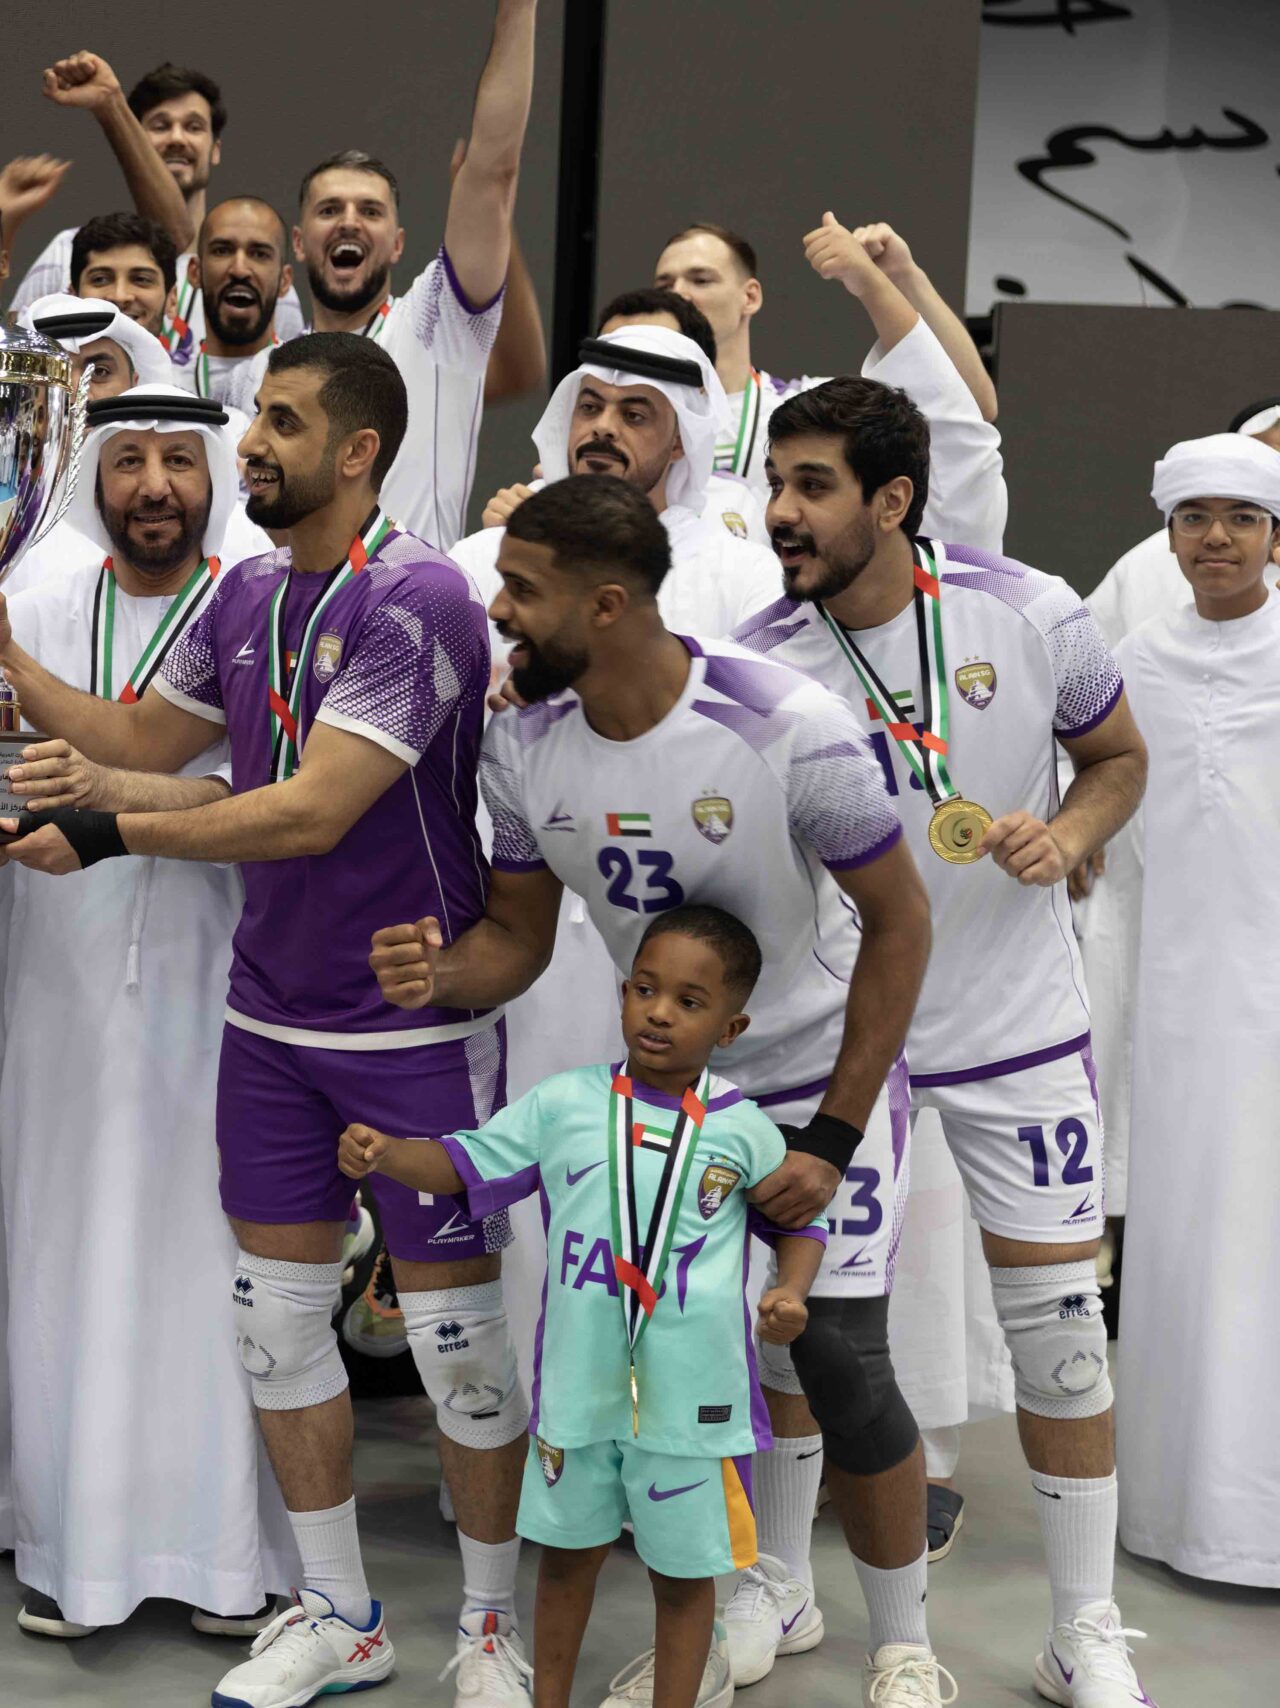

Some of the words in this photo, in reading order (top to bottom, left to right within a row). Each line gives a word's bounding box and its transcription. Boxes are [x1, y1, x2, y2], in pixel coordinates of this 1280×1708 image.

[597, 846, 685, 914] 23
[1016, 1117, 1094, 1187] 12
[827, 1166, 883, 1236] 3
[427, 1234, 475, 1245] PLAYMAKER
